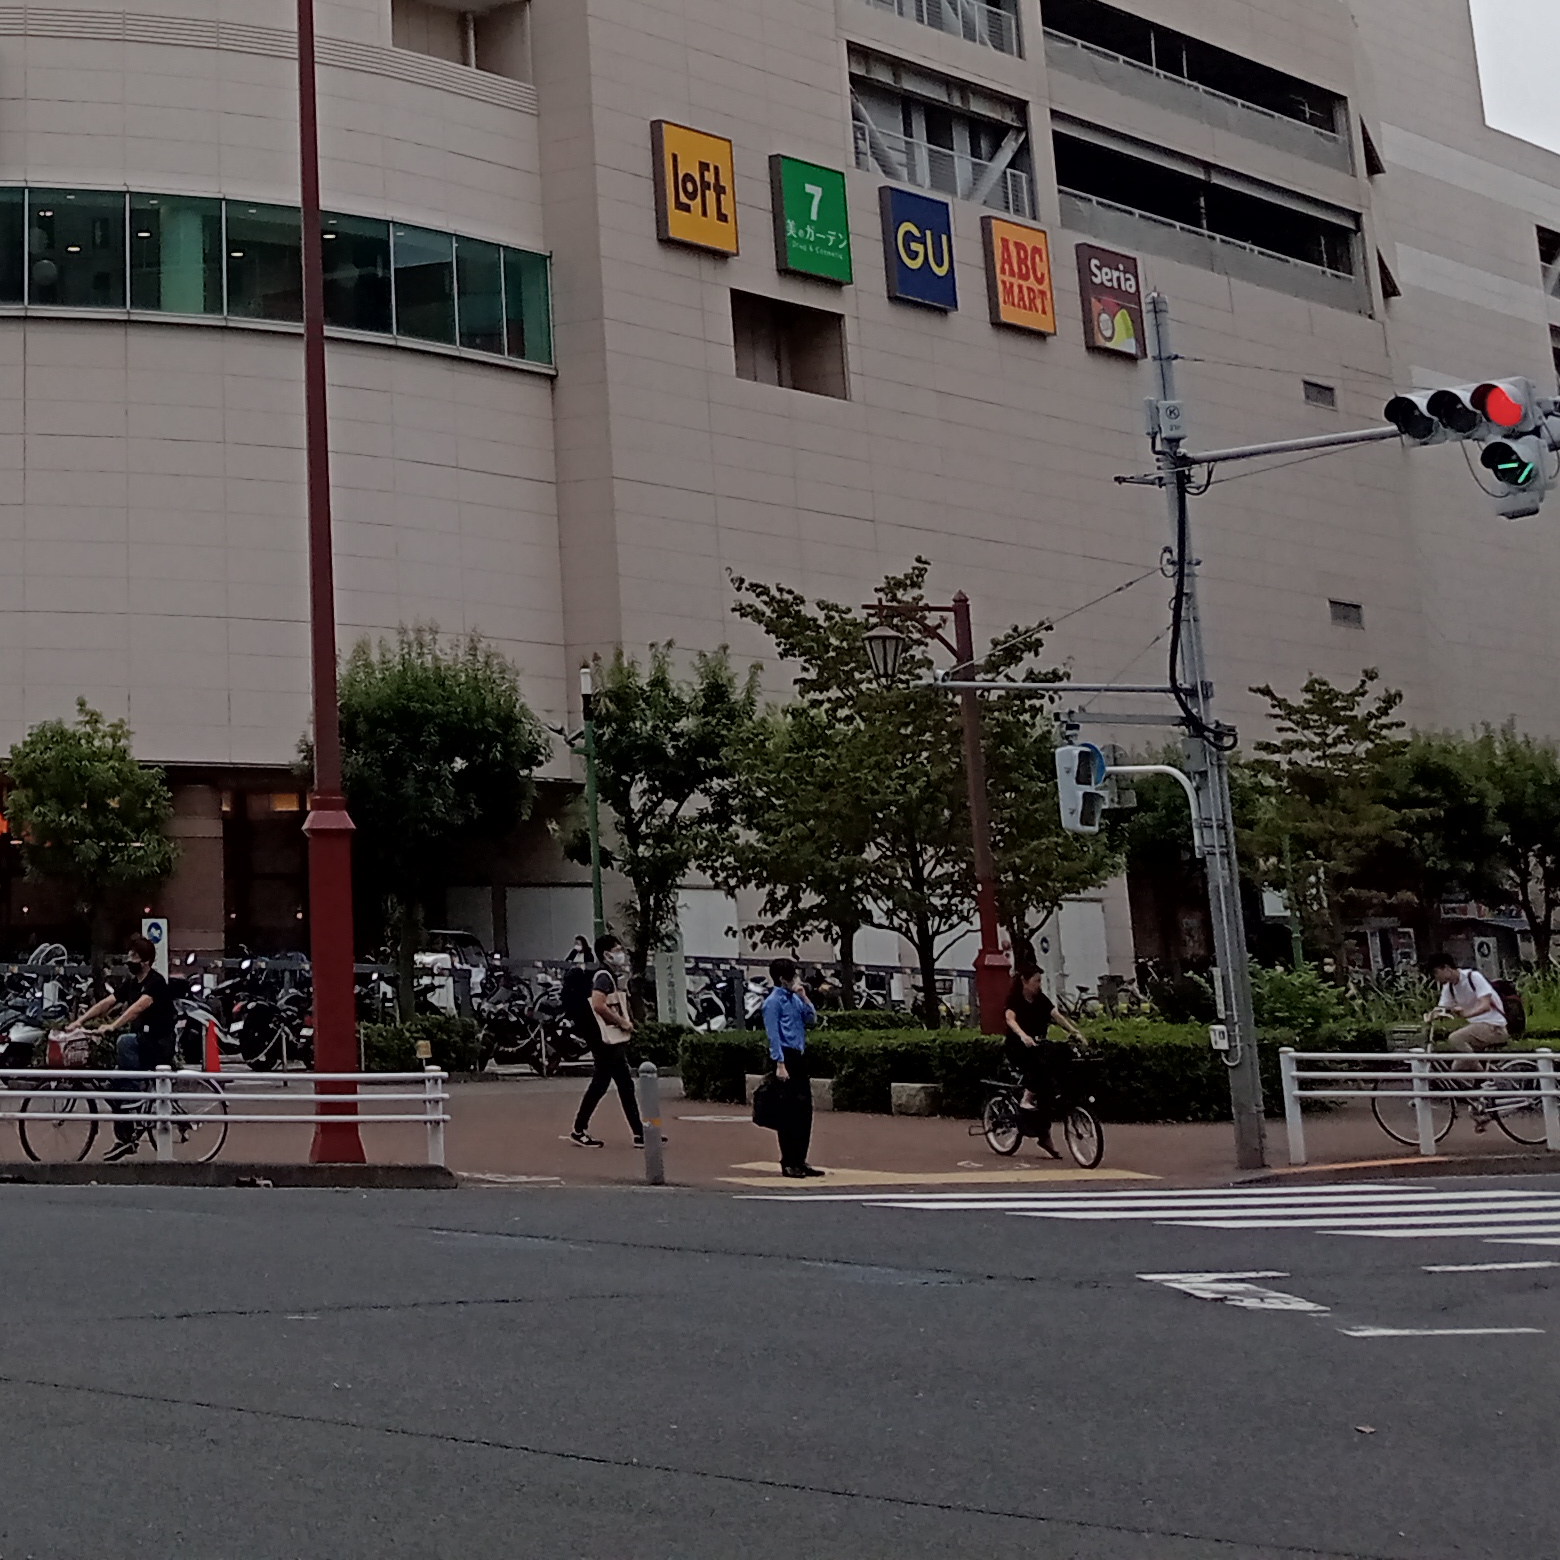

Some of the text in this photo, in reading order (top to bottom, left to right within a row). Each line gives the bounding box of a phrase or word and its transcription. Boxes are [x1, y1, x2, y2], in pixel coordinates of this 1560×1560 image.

[804, 183, 823, 221] 7
[897, 221, 950, 278] GU
[998, 236, 1046, 286] ABC
[1090, 258, 1137, 294] Seria
[1000, 278, 1048, 319] MART
